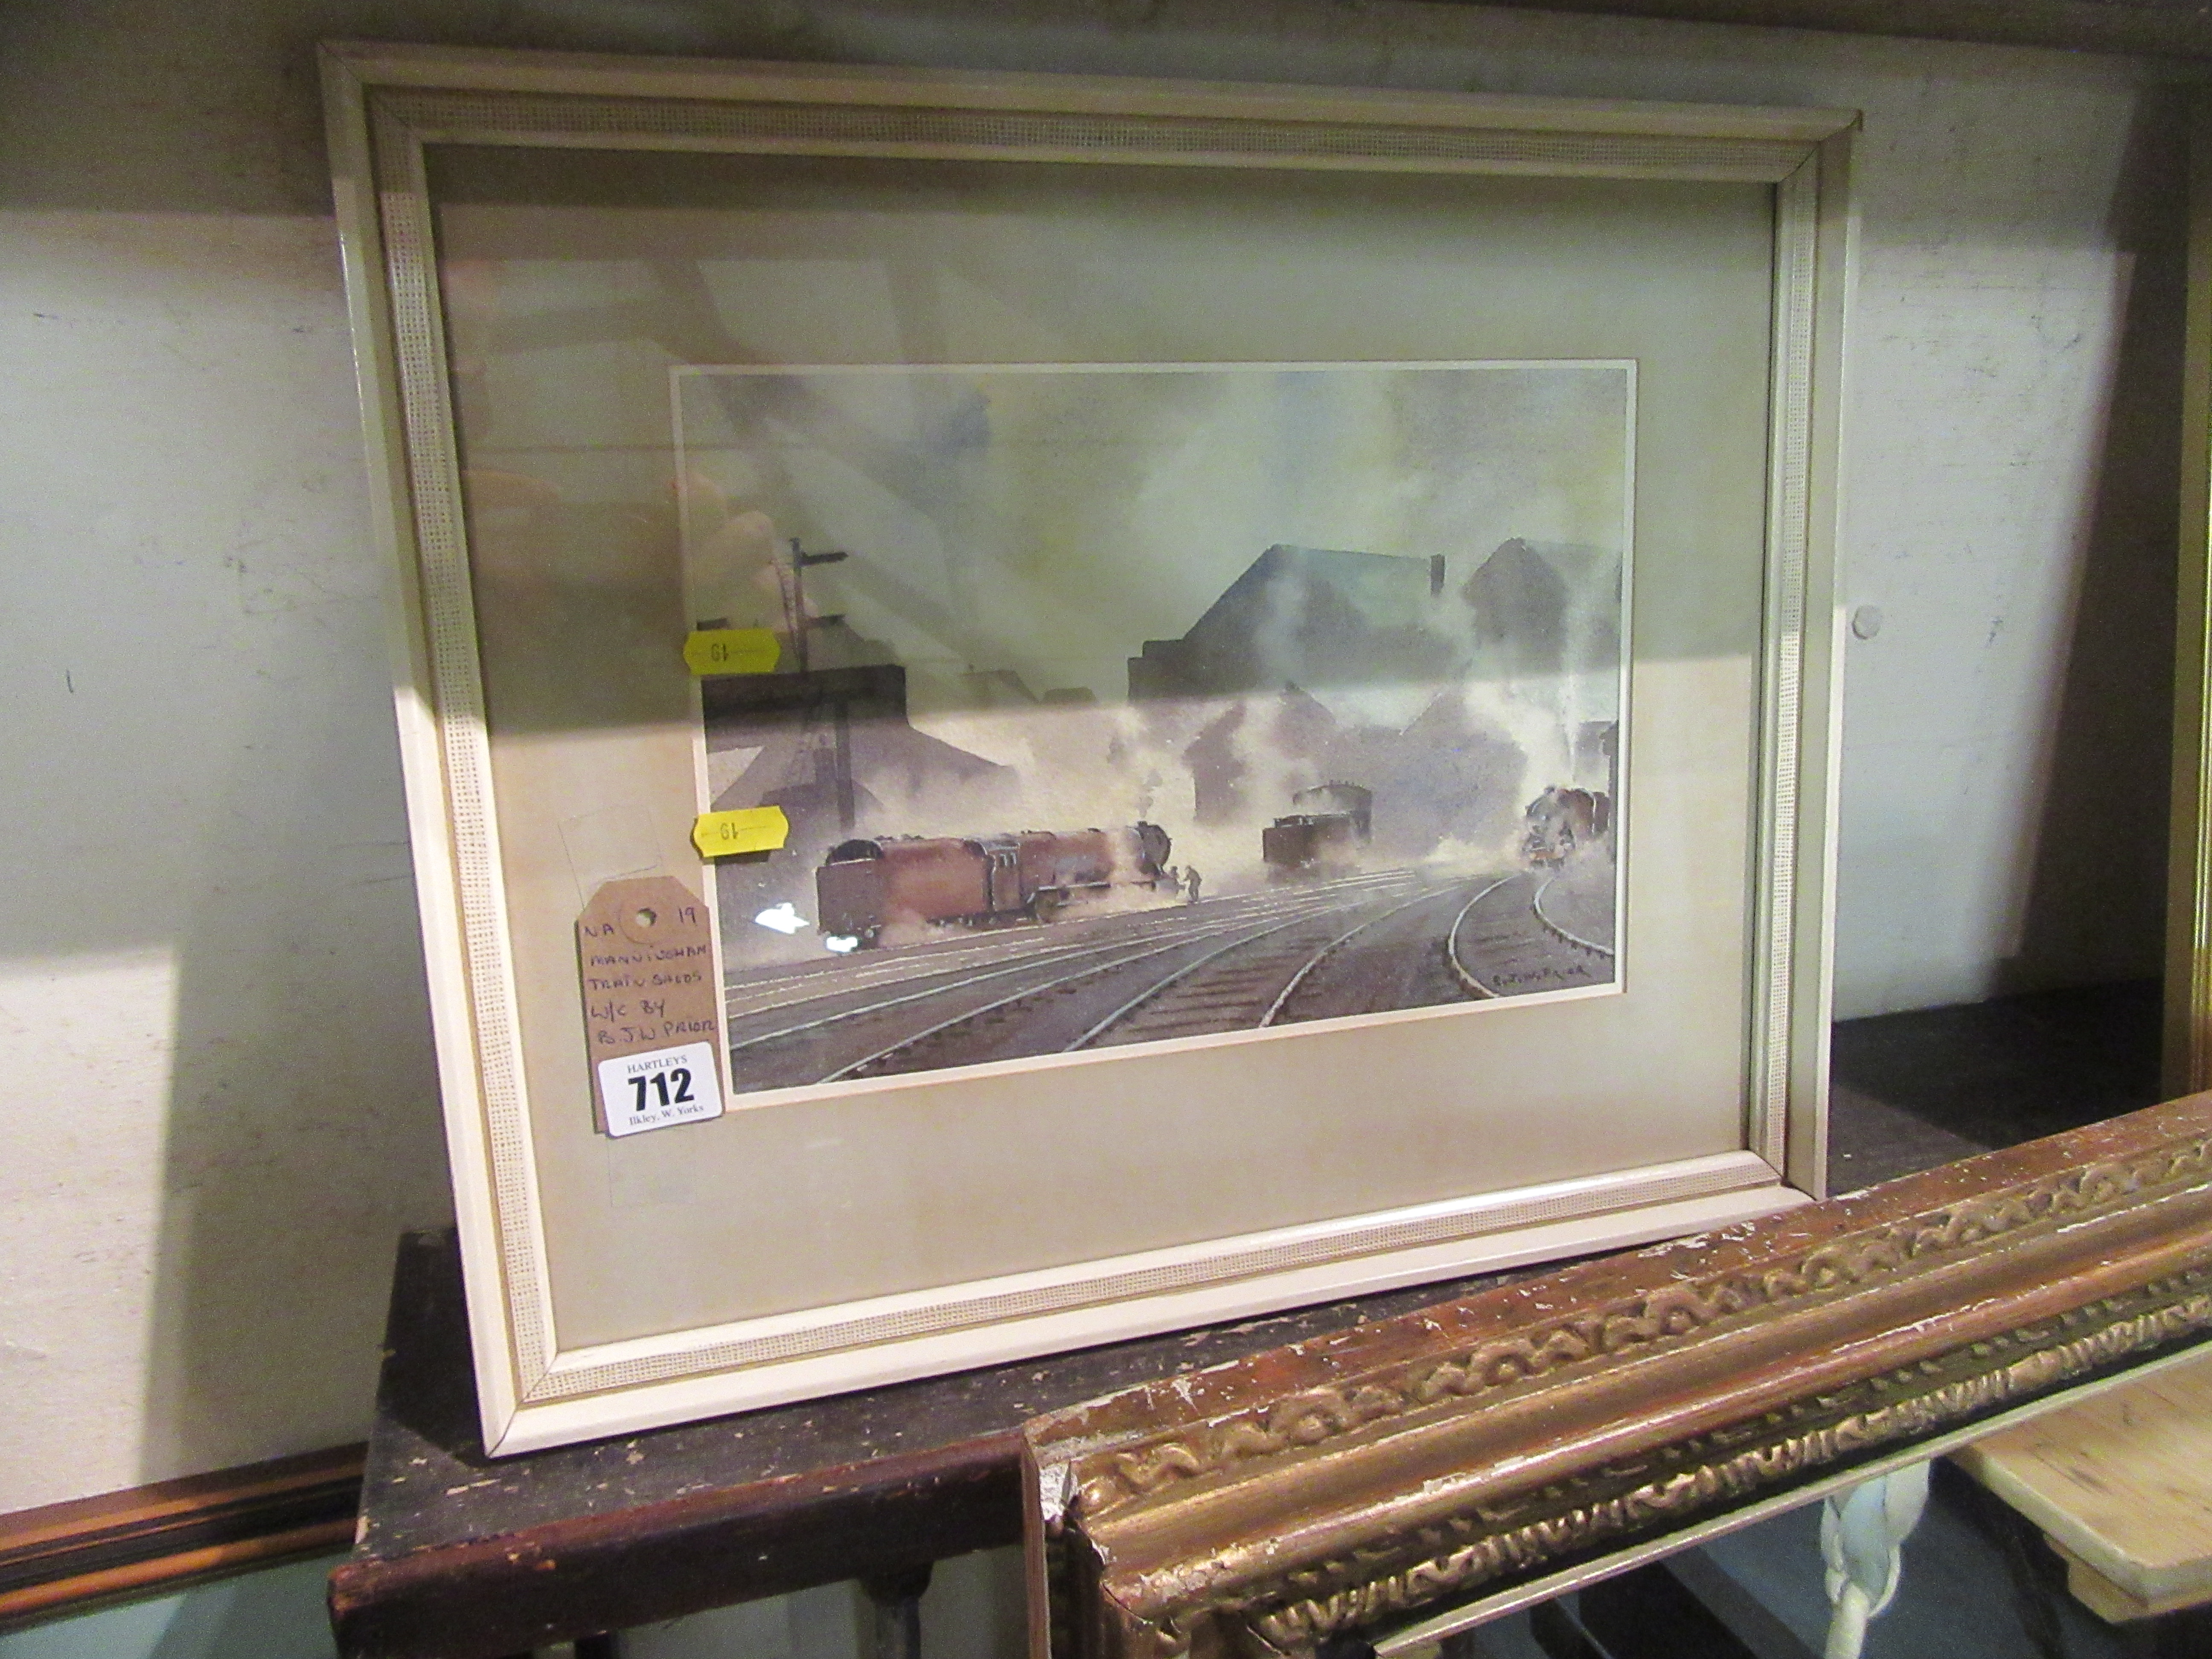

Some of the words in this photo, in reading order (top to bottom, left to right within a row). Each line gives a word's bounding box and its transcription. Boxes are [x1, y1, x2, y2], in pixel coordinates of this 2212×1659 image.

[678, 906, 696, 925] 19
[641, 998, 666, 1018] BY
[627, 1054, 687, 1074] HARTLEYS
[628, 1068, 695, 1112] 712
[661, 1109, 675, 1118] W.
[678, 1104, 704, 1115] Yorks
